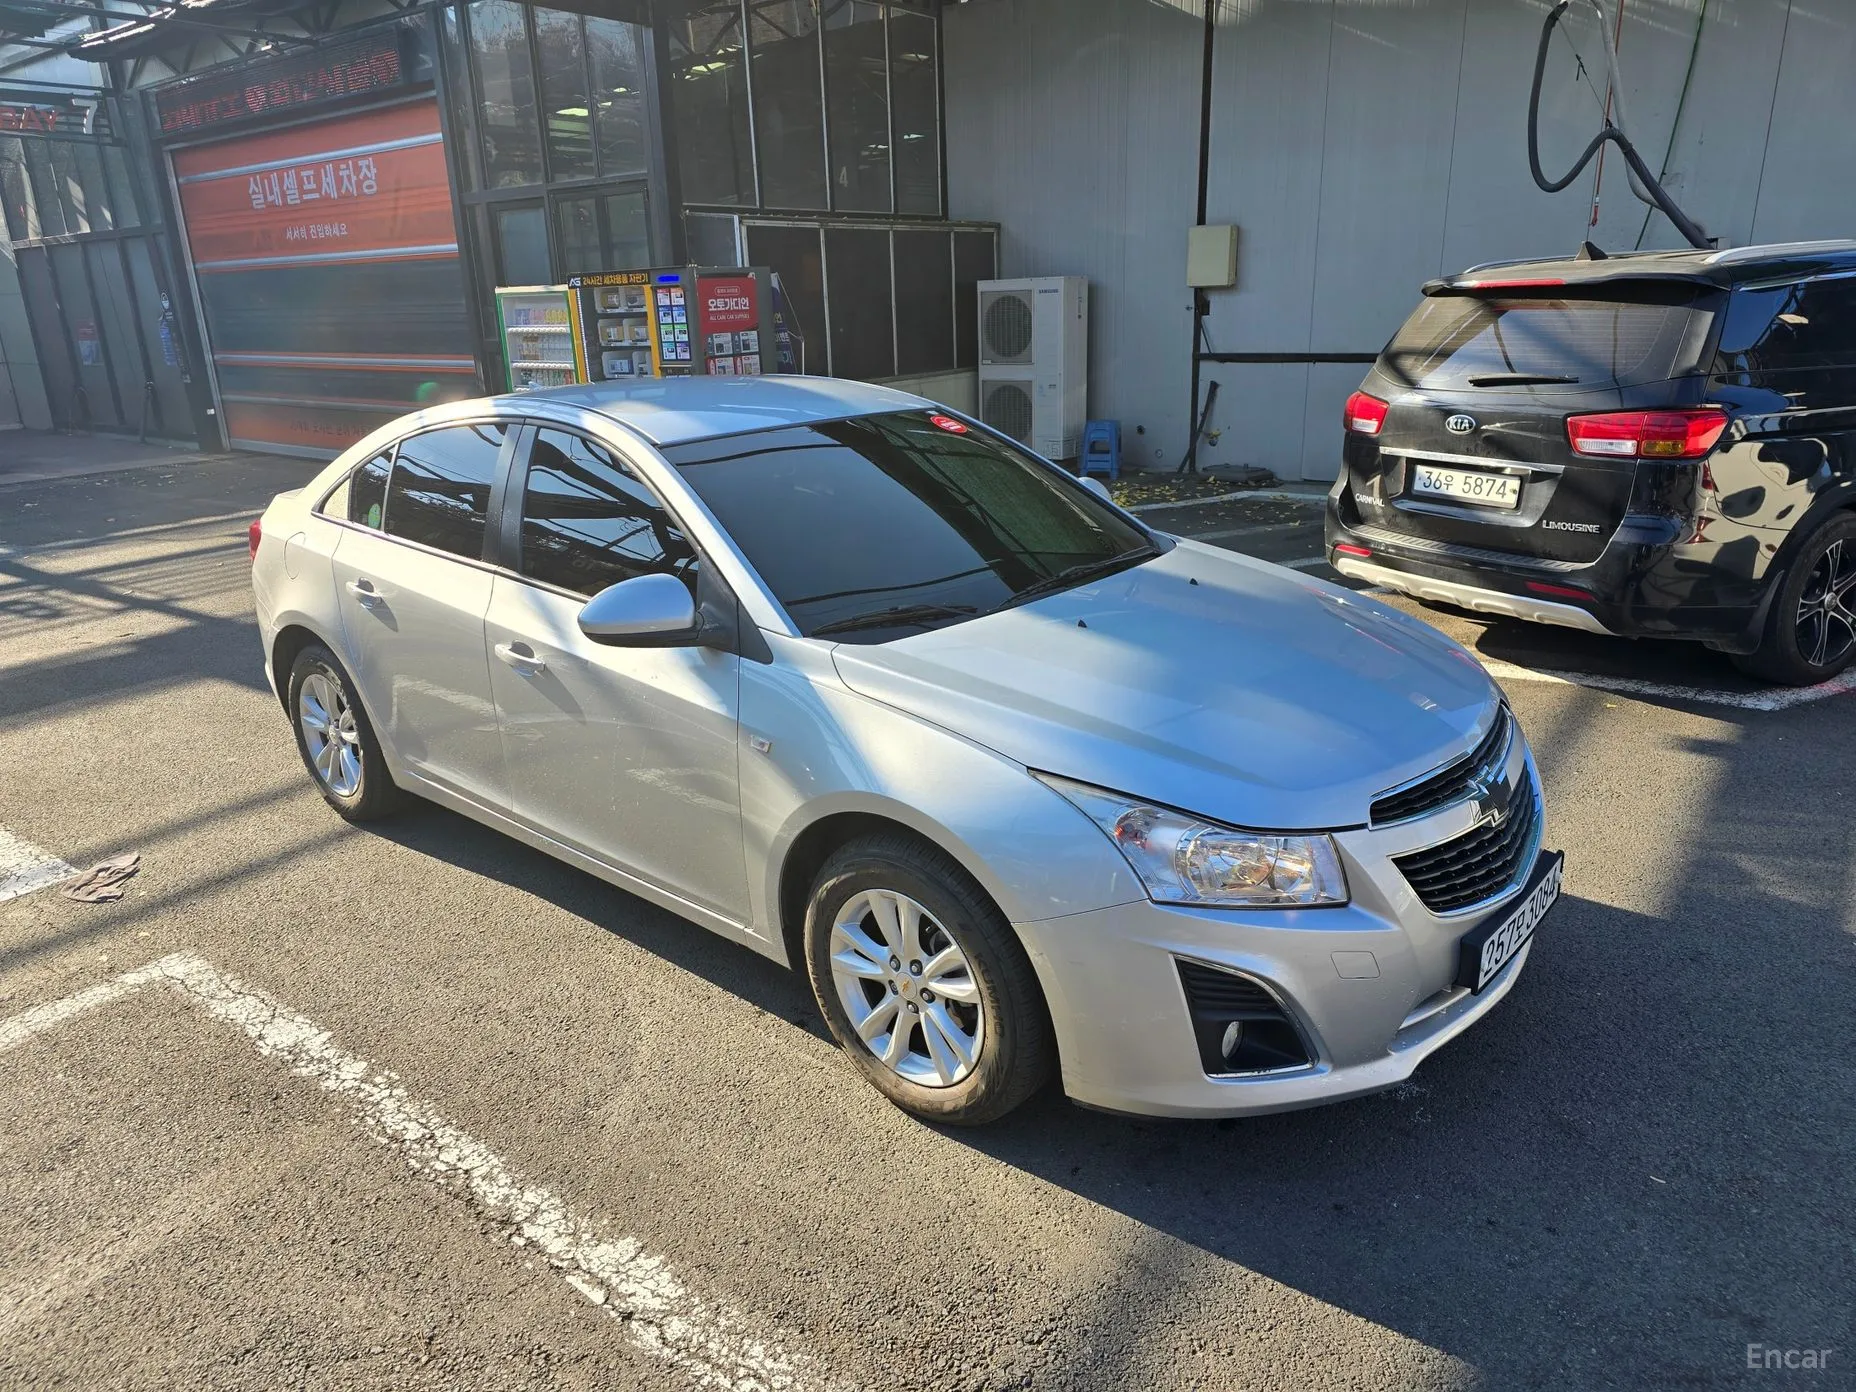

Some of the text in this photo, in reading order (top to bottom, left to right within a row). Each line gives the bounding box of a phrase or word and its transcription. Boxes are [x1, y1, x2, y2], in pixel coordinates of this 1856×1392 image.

[72, 99, 97, 134] 7
[249, 157, 378, 210] 실내셀프세차장
[286, 223, 348, 240] 서서히 진입하세요
[582, 275, 603, 286] 24시간
[629, 272, 649, 285] 자판기
[708, 297, 750, 312] 오토가디언
[1448, 417, 1471, 431] KIA
[1422, 471, 1507, 499] 36우 5874
[1355, 493, 1385, 507] CARNIVAL
[1542, 519, 1601, 534] LIMOUSINE
[1483, 865, 1558, 978] 257모 3084
